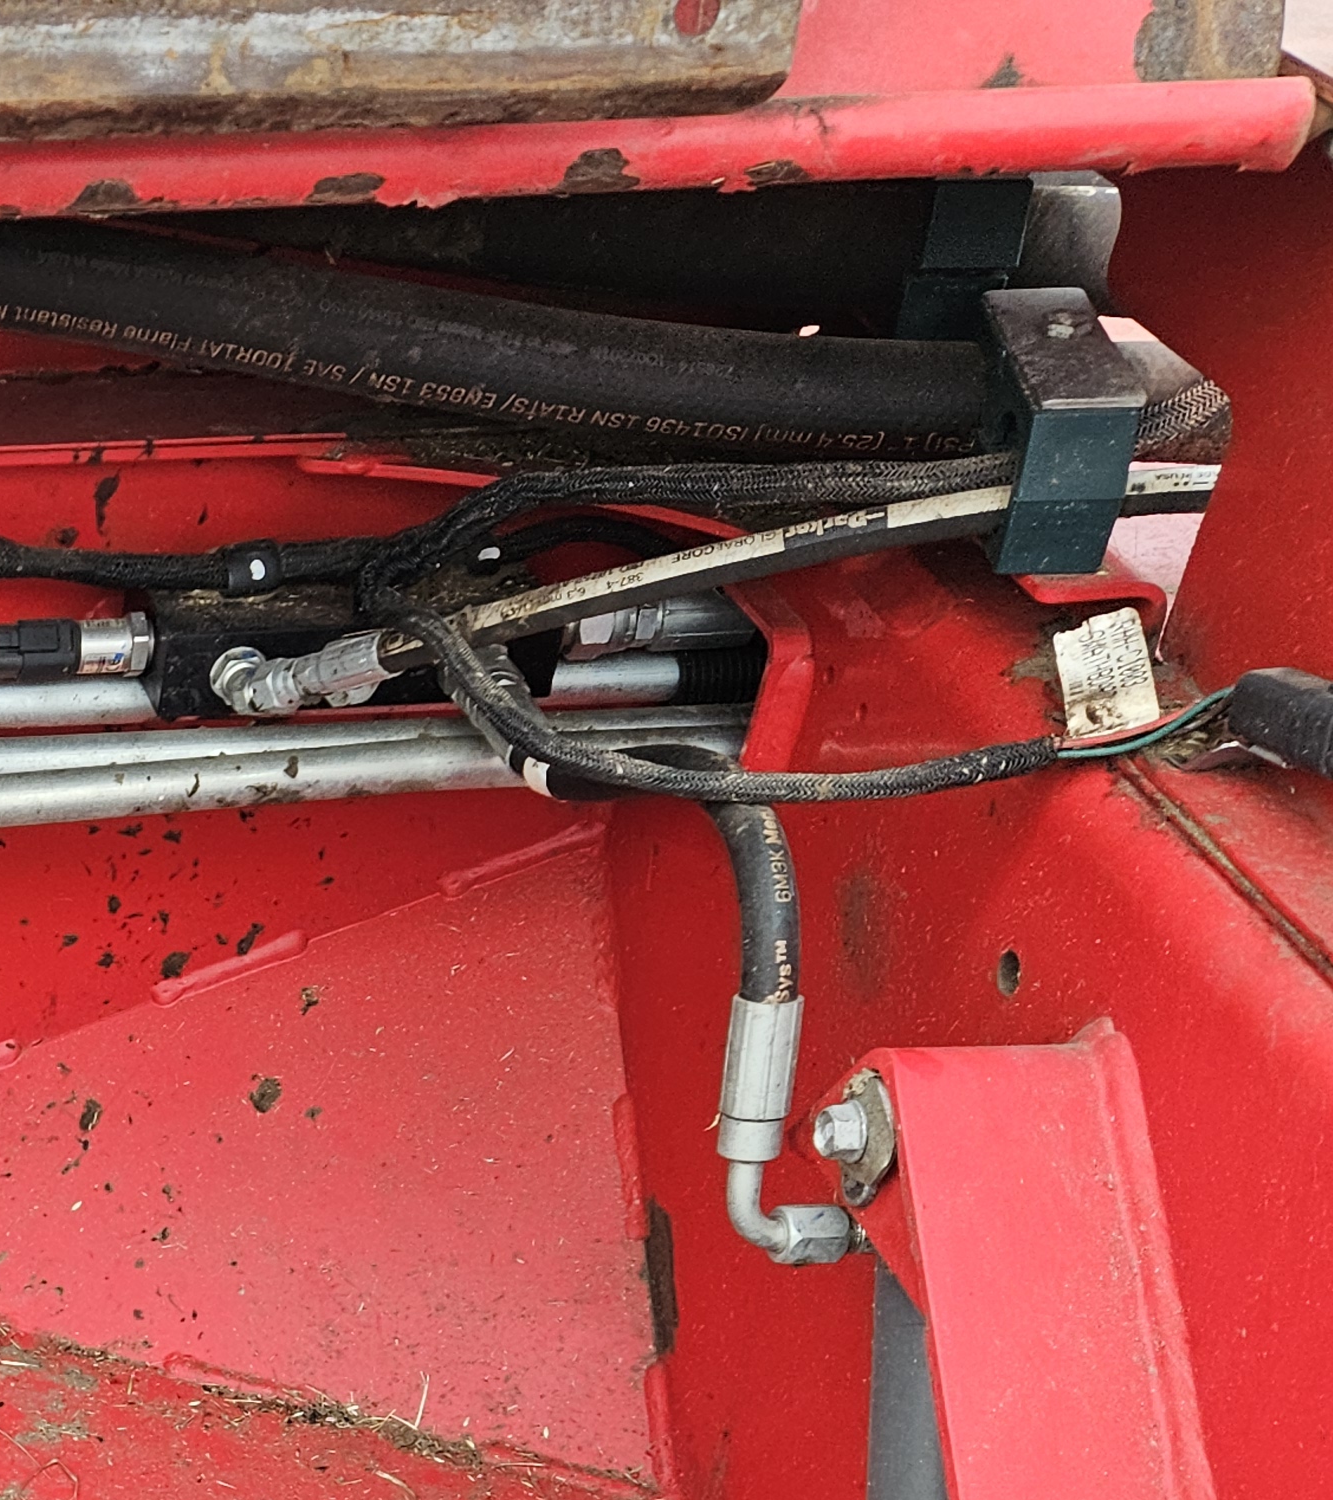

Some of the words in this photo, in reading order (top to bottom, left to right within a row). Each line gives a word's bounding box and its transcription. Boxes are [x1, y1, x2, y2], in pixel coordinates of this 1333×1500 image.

[14, 306, 118, 339] Resistant
[122, 324, 193, 352] Flame
[303, 358, 347, 381] SAE
[367, 370, 417, 396] 1SN
[590, 409, 641, 430] 1SN
[645, 415, 748, 440] ISO1436
[605, 571, 645, 589] 387-4
